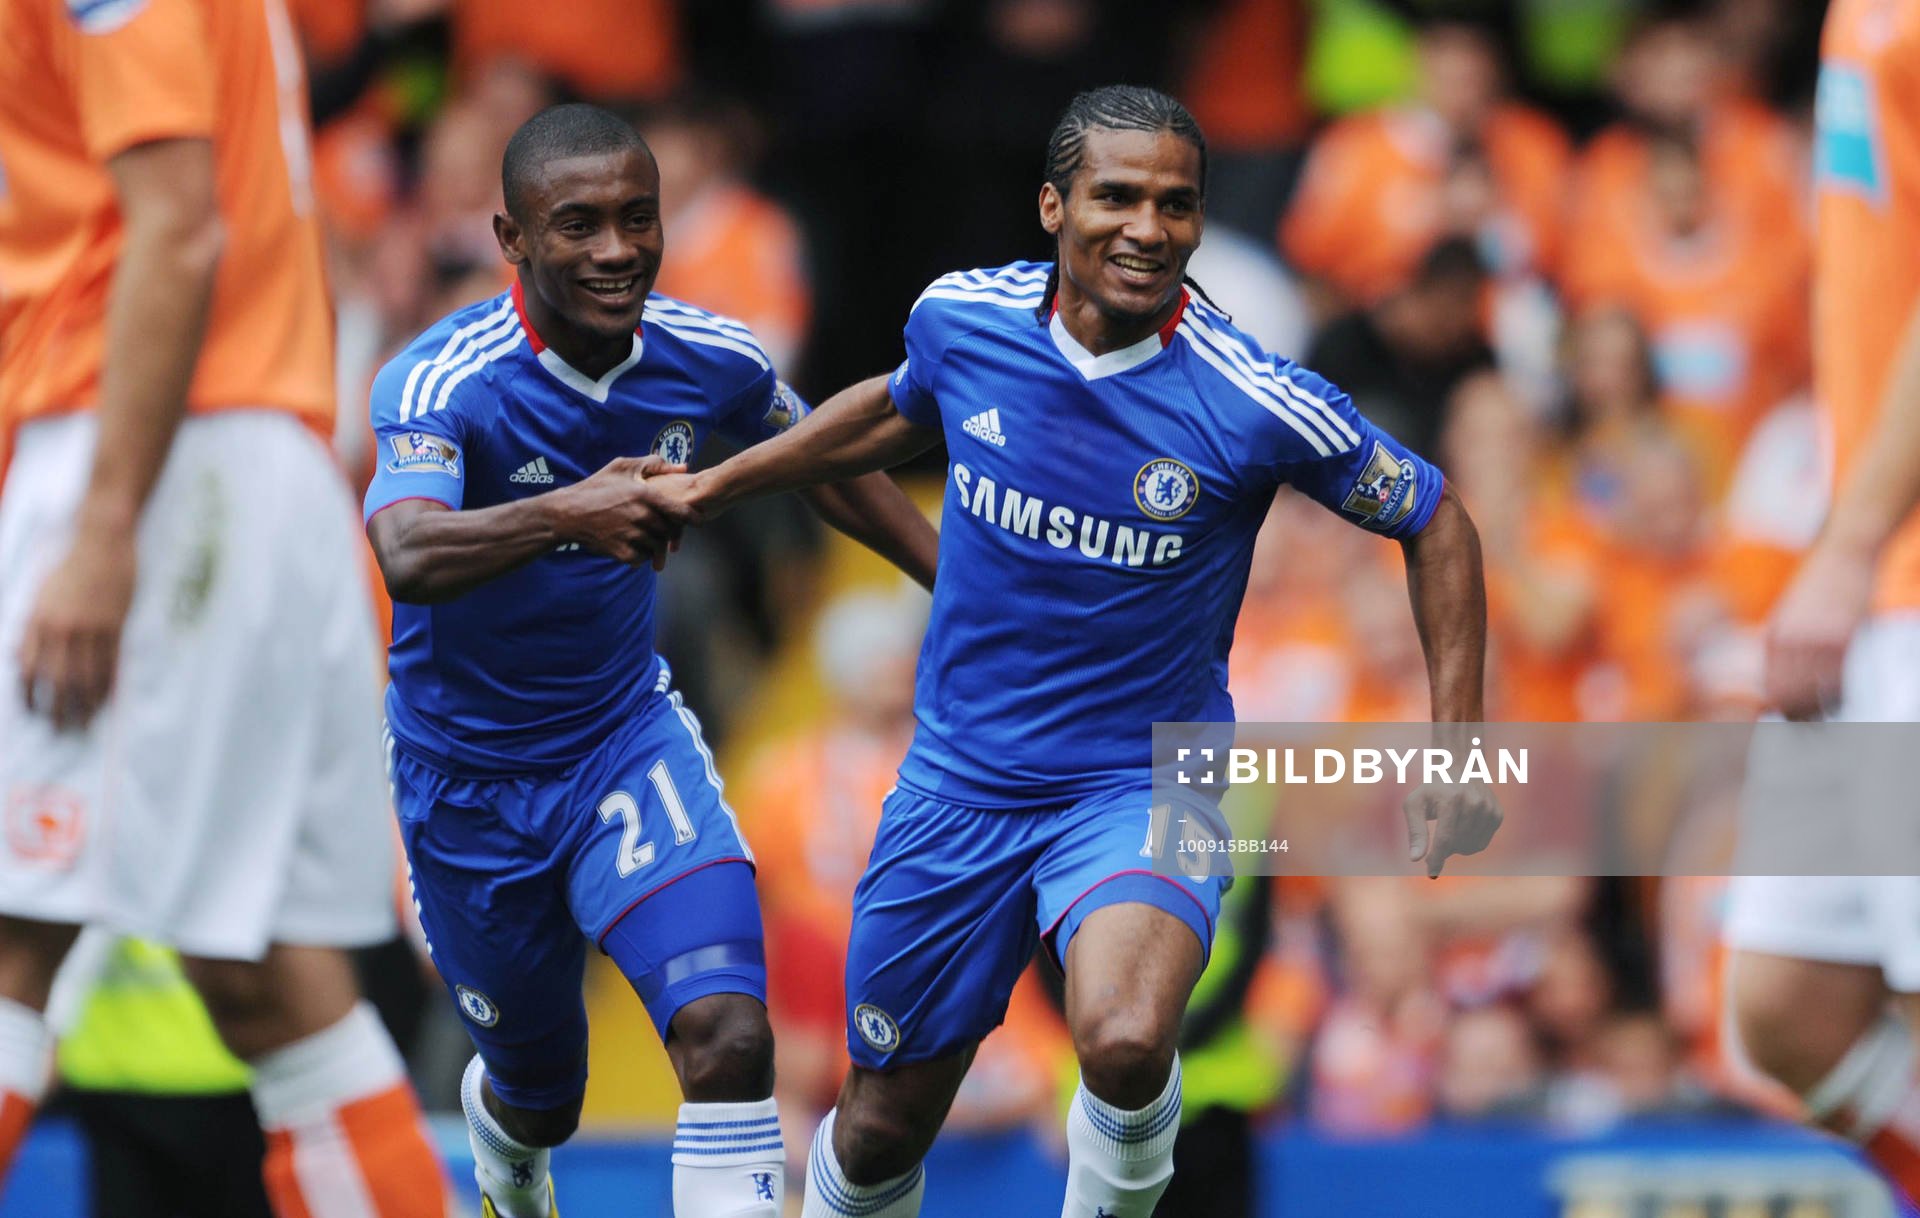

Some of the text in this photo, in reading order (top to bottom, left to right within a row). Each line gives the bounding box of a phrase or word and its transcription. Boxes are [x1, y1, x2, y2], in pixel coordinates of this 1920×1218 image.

[962, 420, 1006, 447] adidas
[509, 473, 554, 484] adidas
[1151, 462, 1190, 480] CHELSEA
[953, 463, 1183, 567] SAMSUNG
[1378, 480, 1405, 520] BARCLAYS
[596, 759, 696, 878] 21
[1139, 803, 1211, 884] 15
